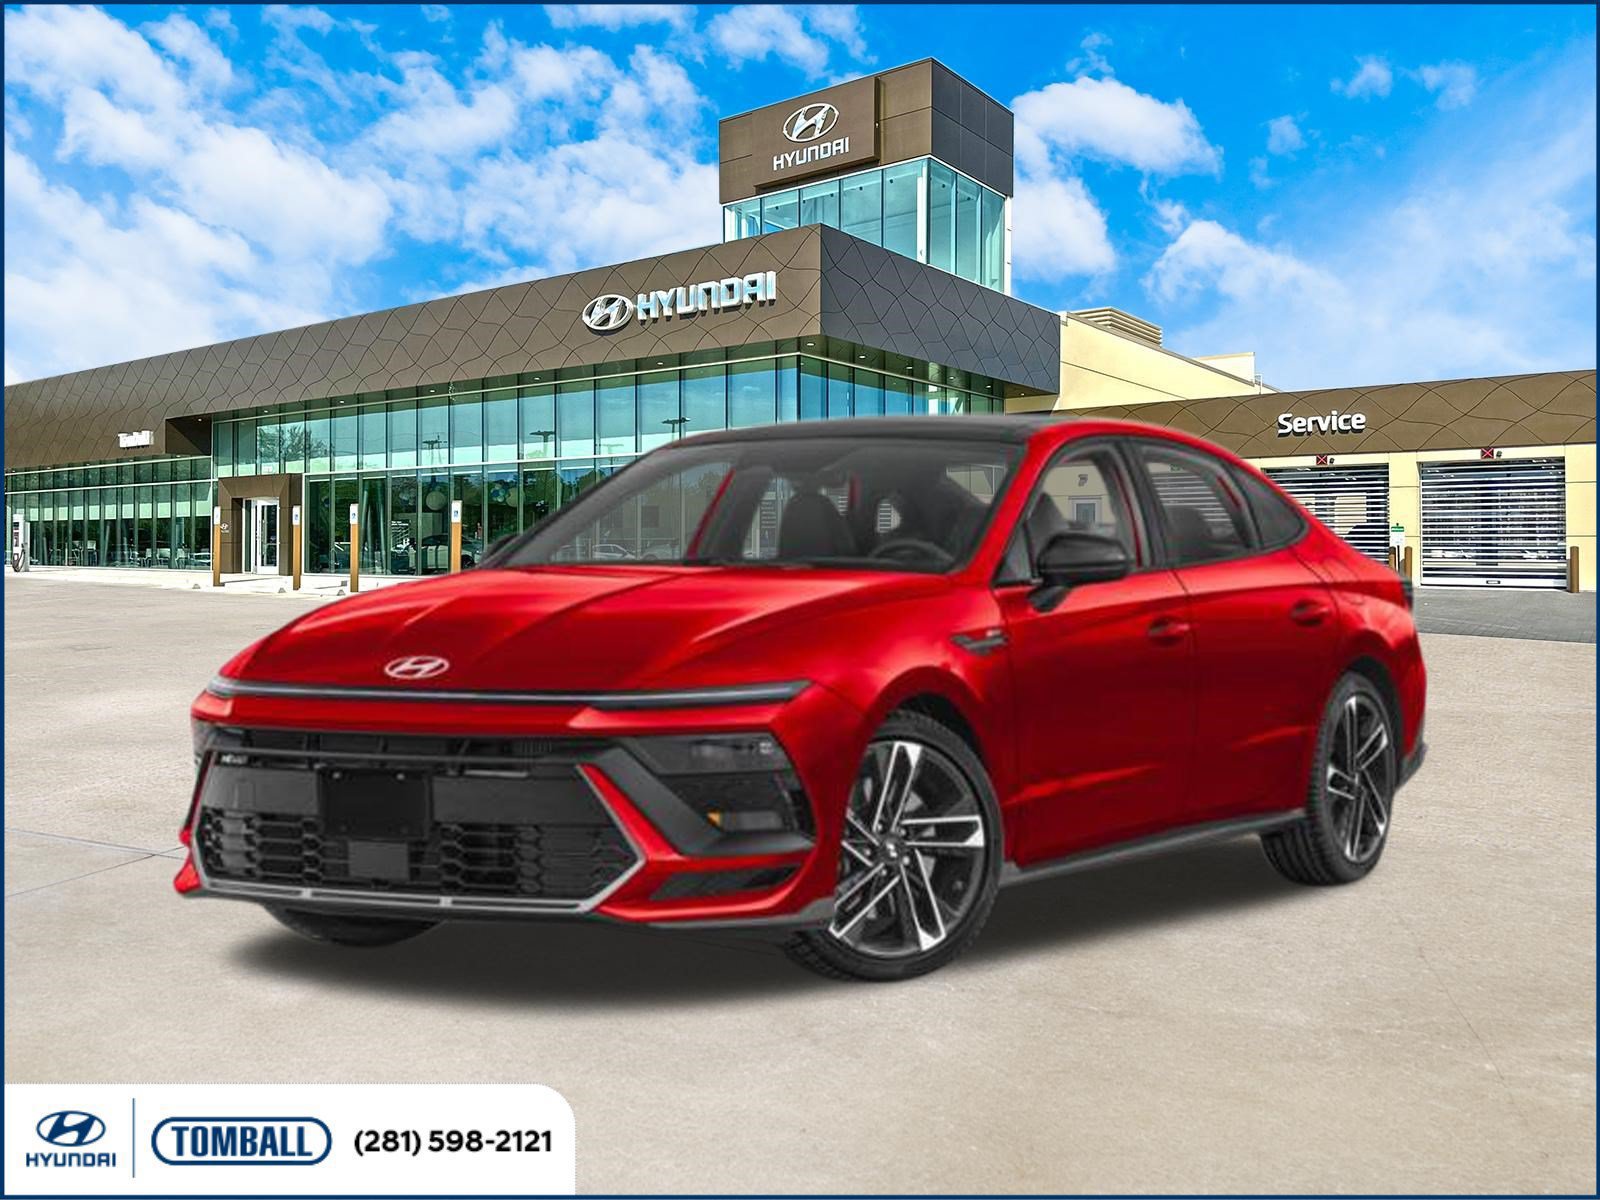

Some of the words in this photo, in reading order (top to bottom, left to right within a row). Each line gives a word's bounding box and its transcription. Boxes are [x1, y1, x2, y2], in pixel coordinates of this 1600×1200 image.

[773, 137, 850, 171] HYUNDAI
[637, 270, 776, 321] HYUNDAI
[1277, 410, 1366, 435] Service
